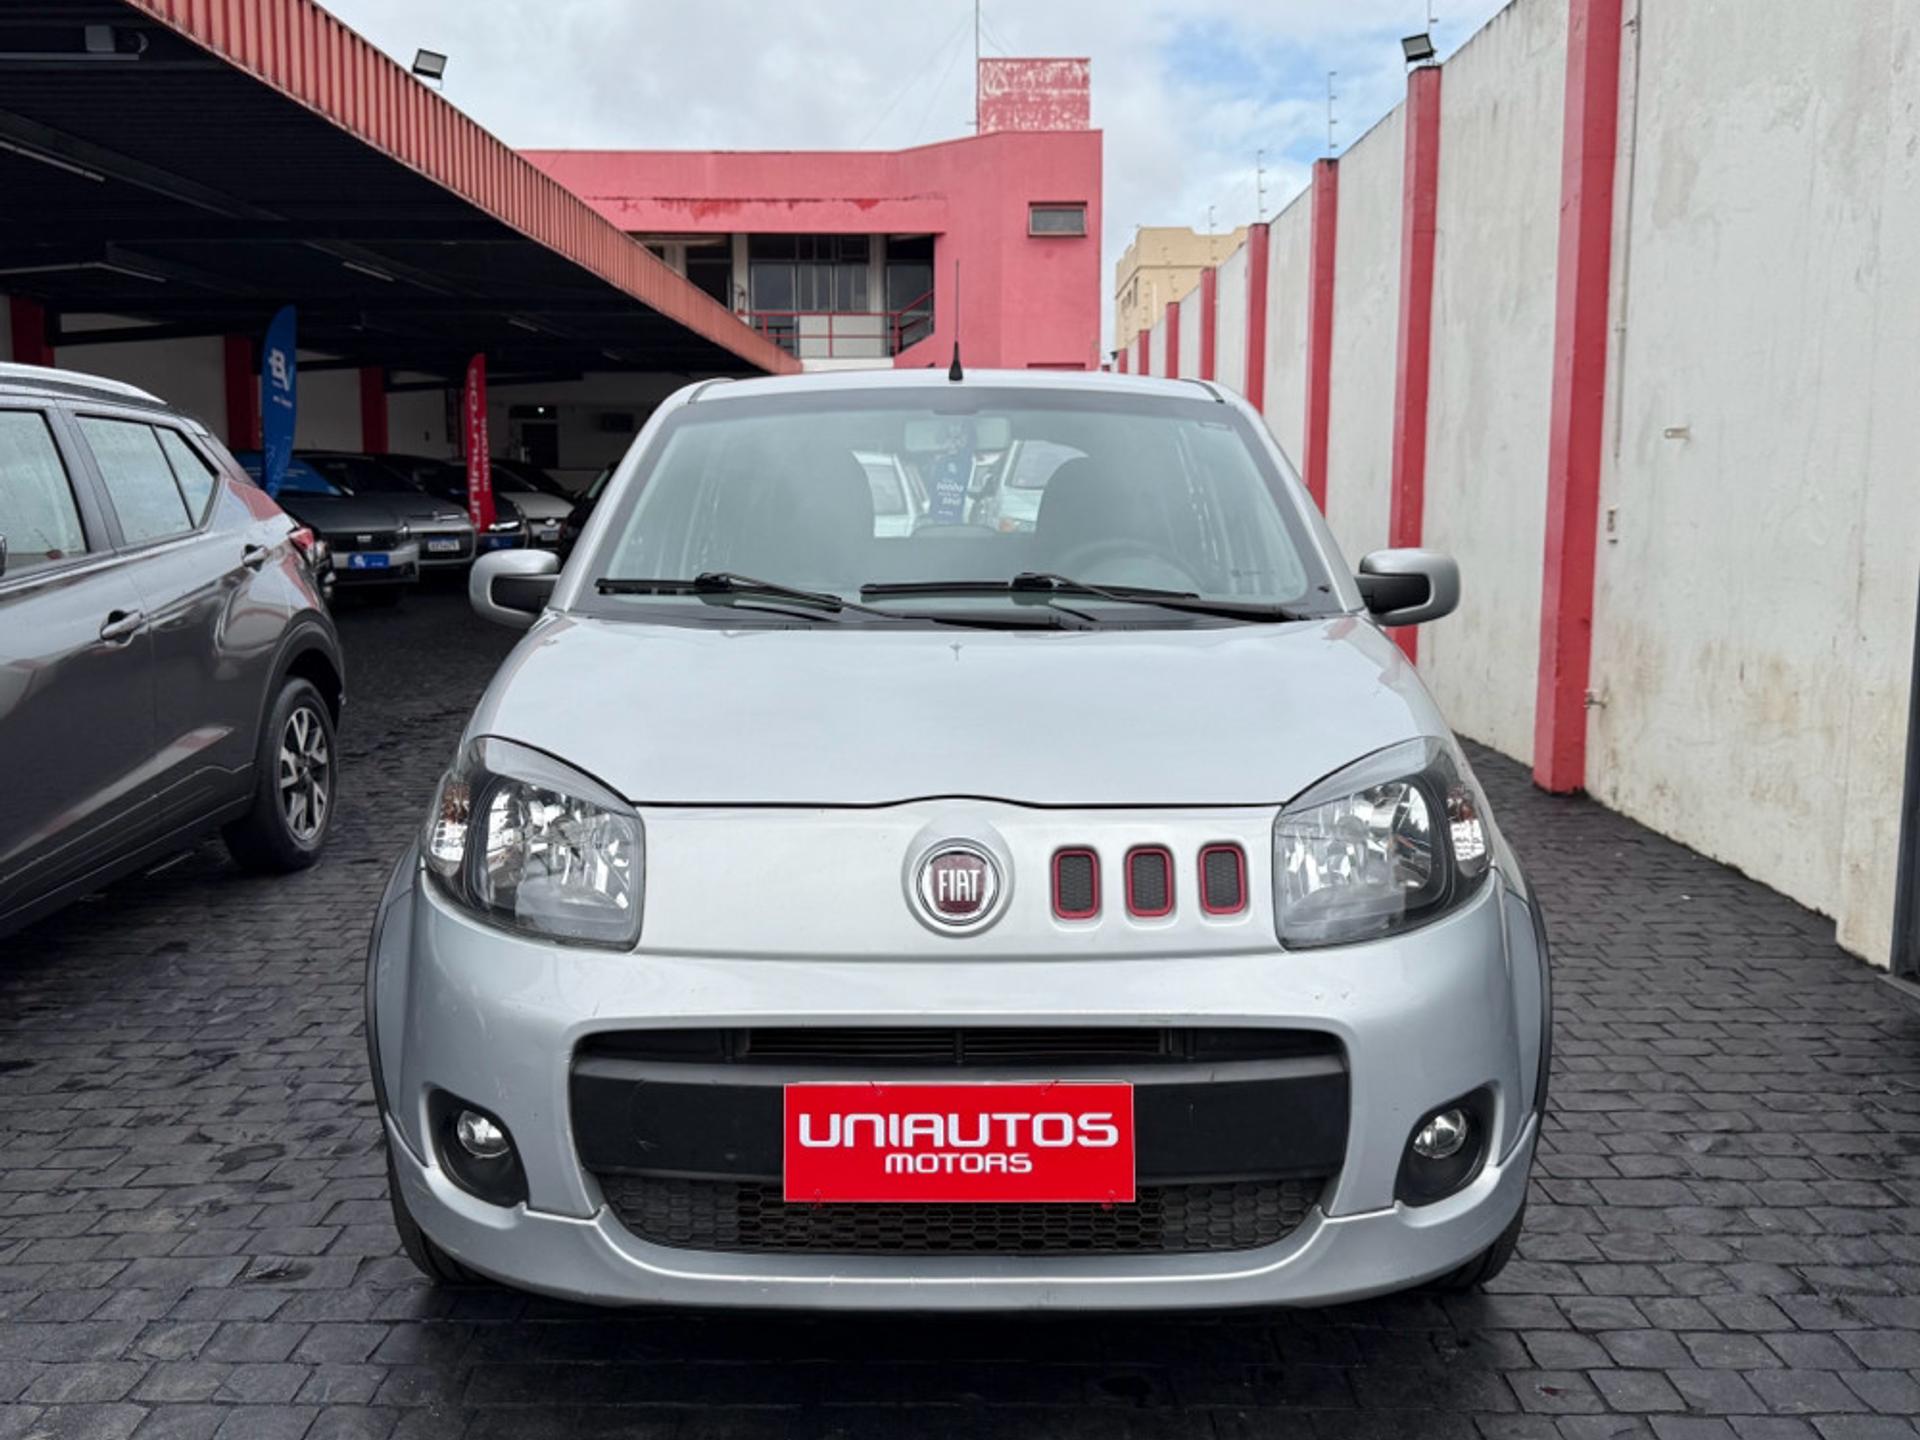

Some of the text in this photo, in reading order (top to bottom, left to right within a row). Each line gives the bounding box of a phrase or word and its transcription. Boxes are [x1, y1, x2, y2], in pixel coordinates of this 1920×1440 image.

[937, 869, 981, 902] FIAT
[799, 1112, 1119, 1147] UNIAUTOS
[884, 1153, 1033, 1174] MOTORS
